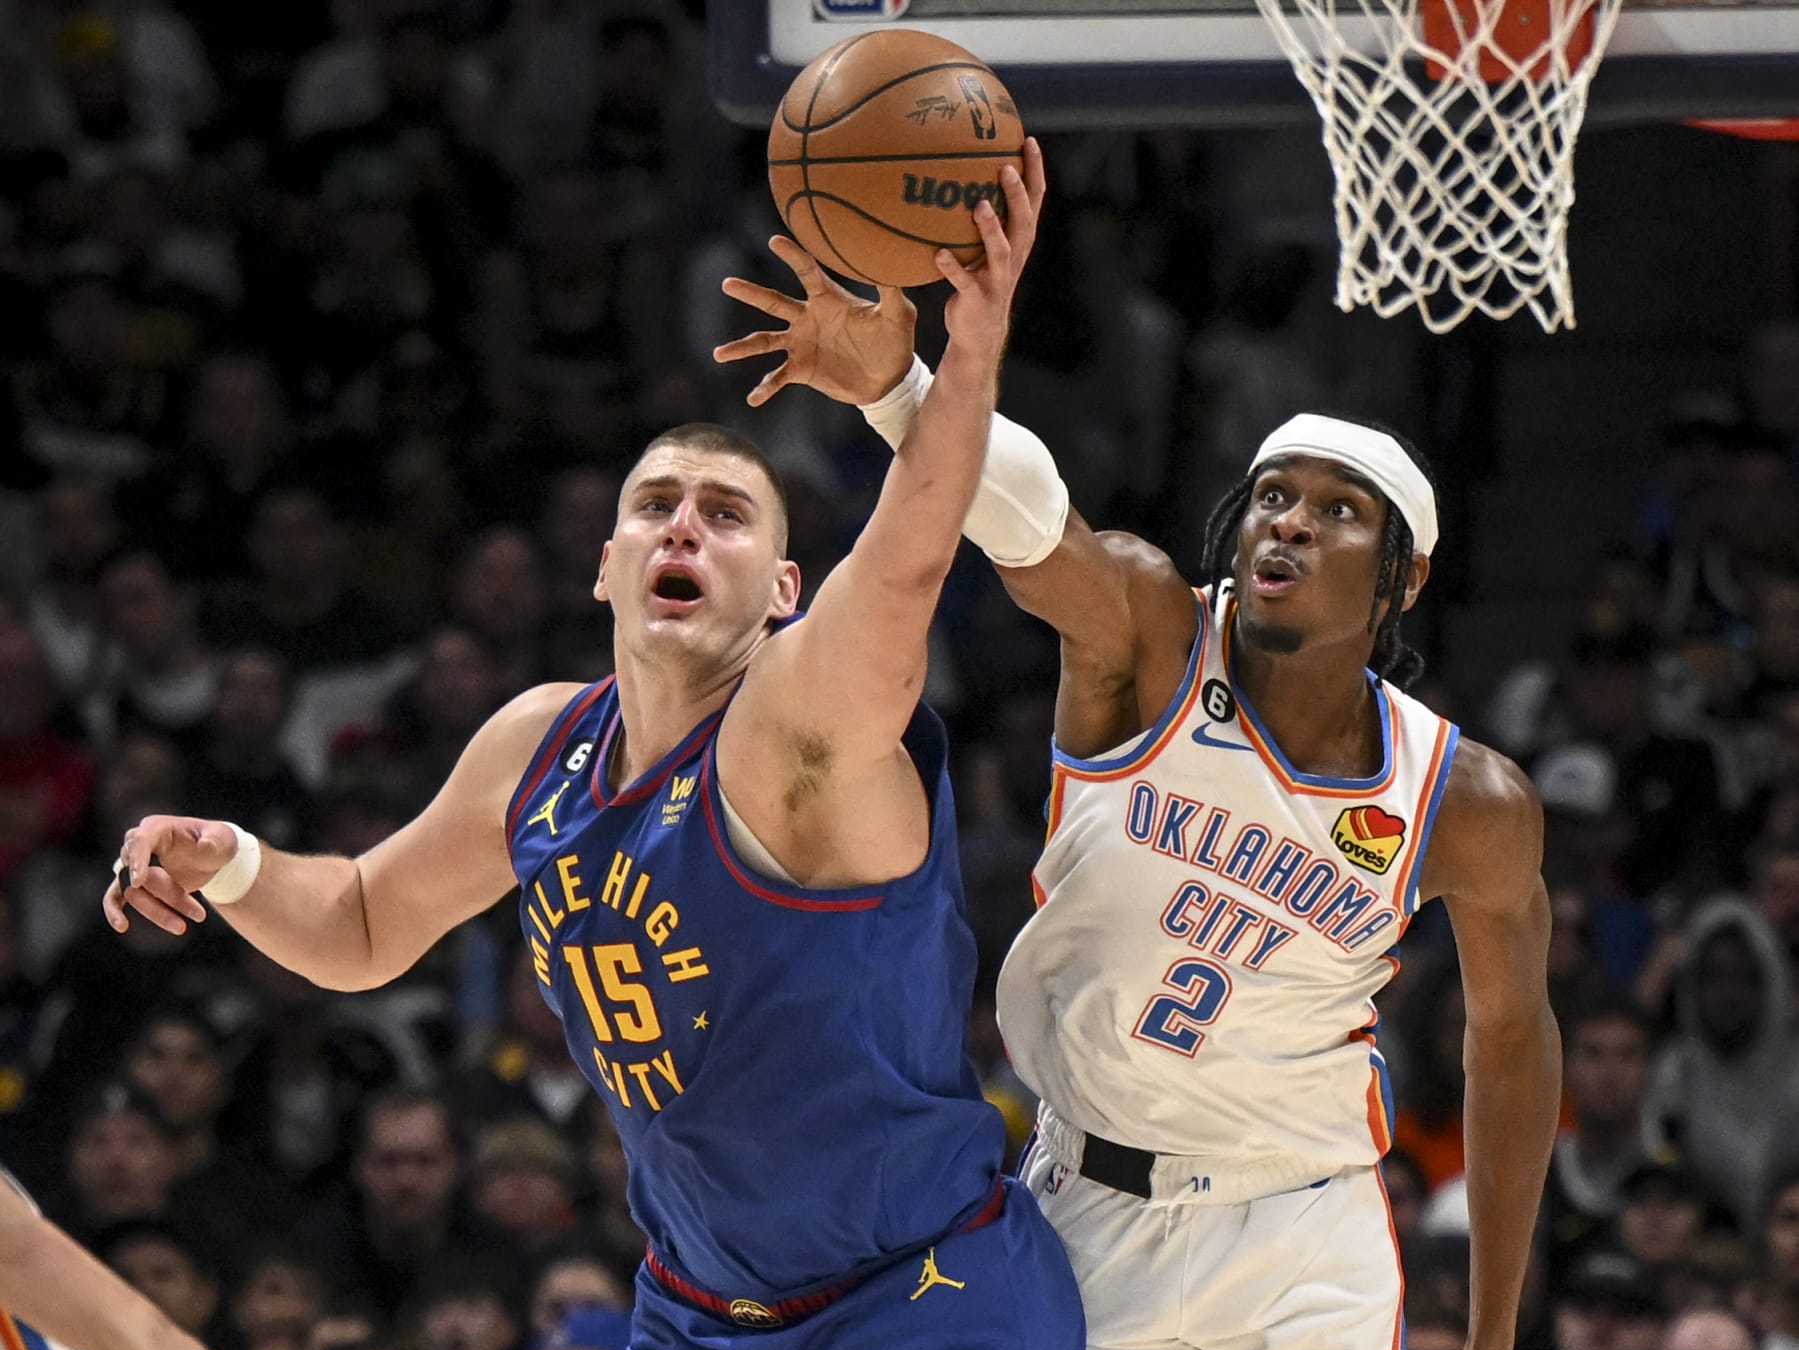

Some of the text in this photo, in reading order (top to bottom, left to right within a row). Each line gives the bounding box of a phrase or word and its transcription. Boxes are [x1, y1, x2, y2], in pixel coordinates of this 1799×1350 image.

[1208, 685, 1228, 718] 6
[566, 742, 593, 771] 6
[1125, 780, 1401, 953] OKLAHOMA
[528, 850, 710, 987] MILE HIGH
[1160, 879, 1298, 971] CITY
[562, 943, 662, 1044] 15
[1131, 957, 1232, 1058] 2
[593, 1046, 684, 1111] CITY
